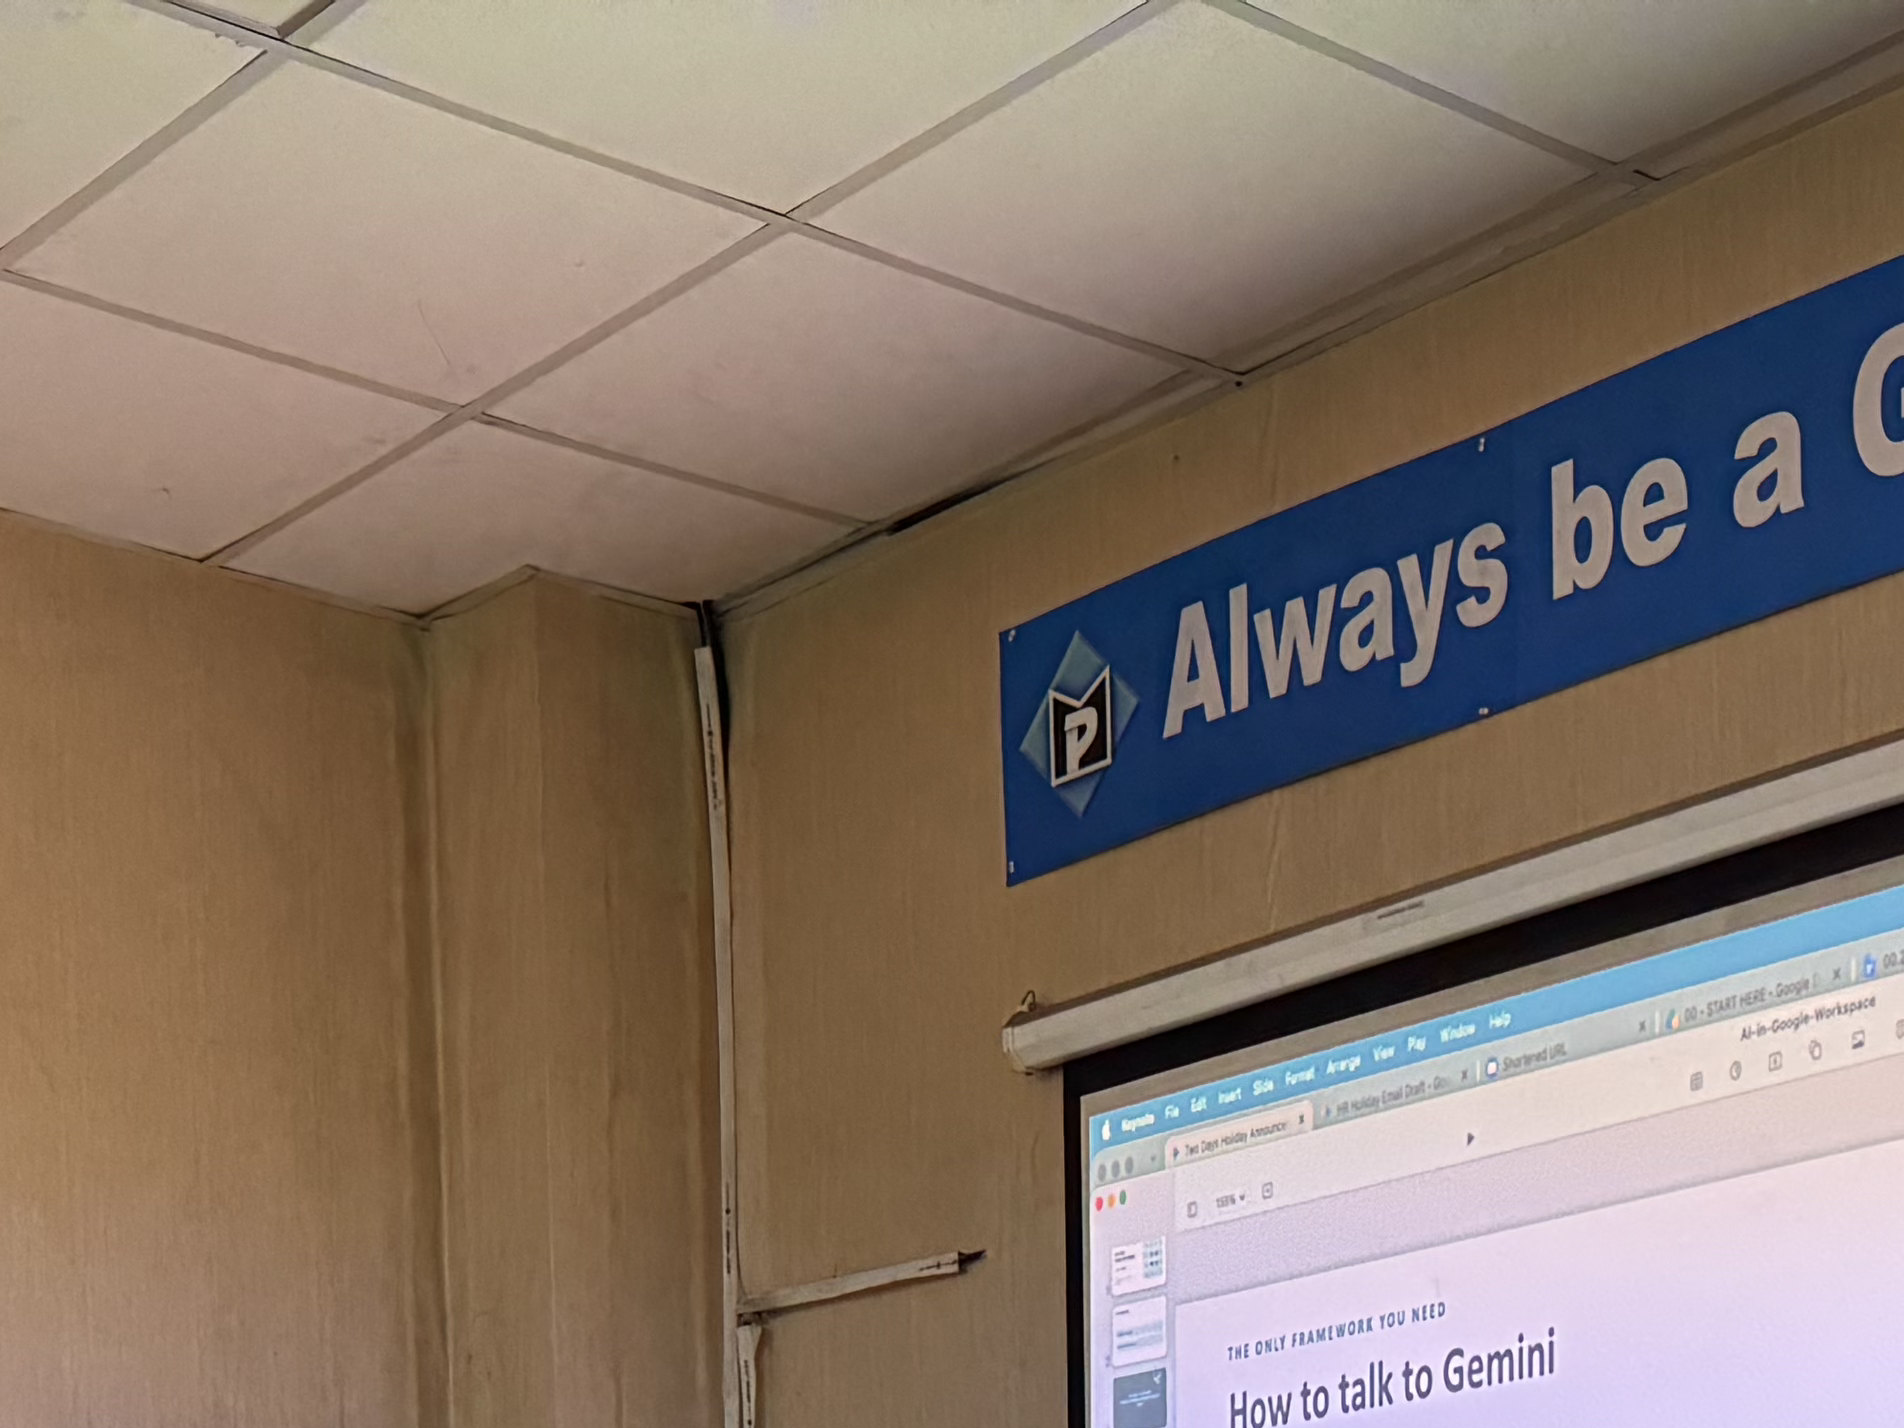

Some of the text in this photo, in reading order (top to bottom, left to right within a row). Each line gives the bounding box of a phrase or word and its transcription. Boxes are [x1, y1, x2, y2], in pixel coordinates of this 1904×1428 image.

[1162, 520, 1509, 740] Always
[1550, 457, 1688, 602] be
[1732, 410, 1805, 528] a
[1706, 994, 1738, 1019] START
[1776, 975, 1810, 998] Google
[1739, 995, 1877, 1042] AI-in-Google-Workspace
[1252, 1077, 1275, 1096] Slide
[1284, 1066, 1316, 1087] Format
[1326, 1055, 1362, 1076] Arrange
[1372, 1044, 1395, 1063] View
[1407, 1035, 1427, 1053] Play
[1439, 1022, 1476, 1044] Window
[1488, 1011, 1512, 1030] Help
[1227, 1300, 1447, 1362] THE ONLY FRAMEWORK YOU NEED
[1301, 1380, 1330, 1422] to
[1338, 1360, 1394, 1414] talk
[1402, 1359, 1434, 1401] to
[1442, 1325, 1557, 1394] Gemini
